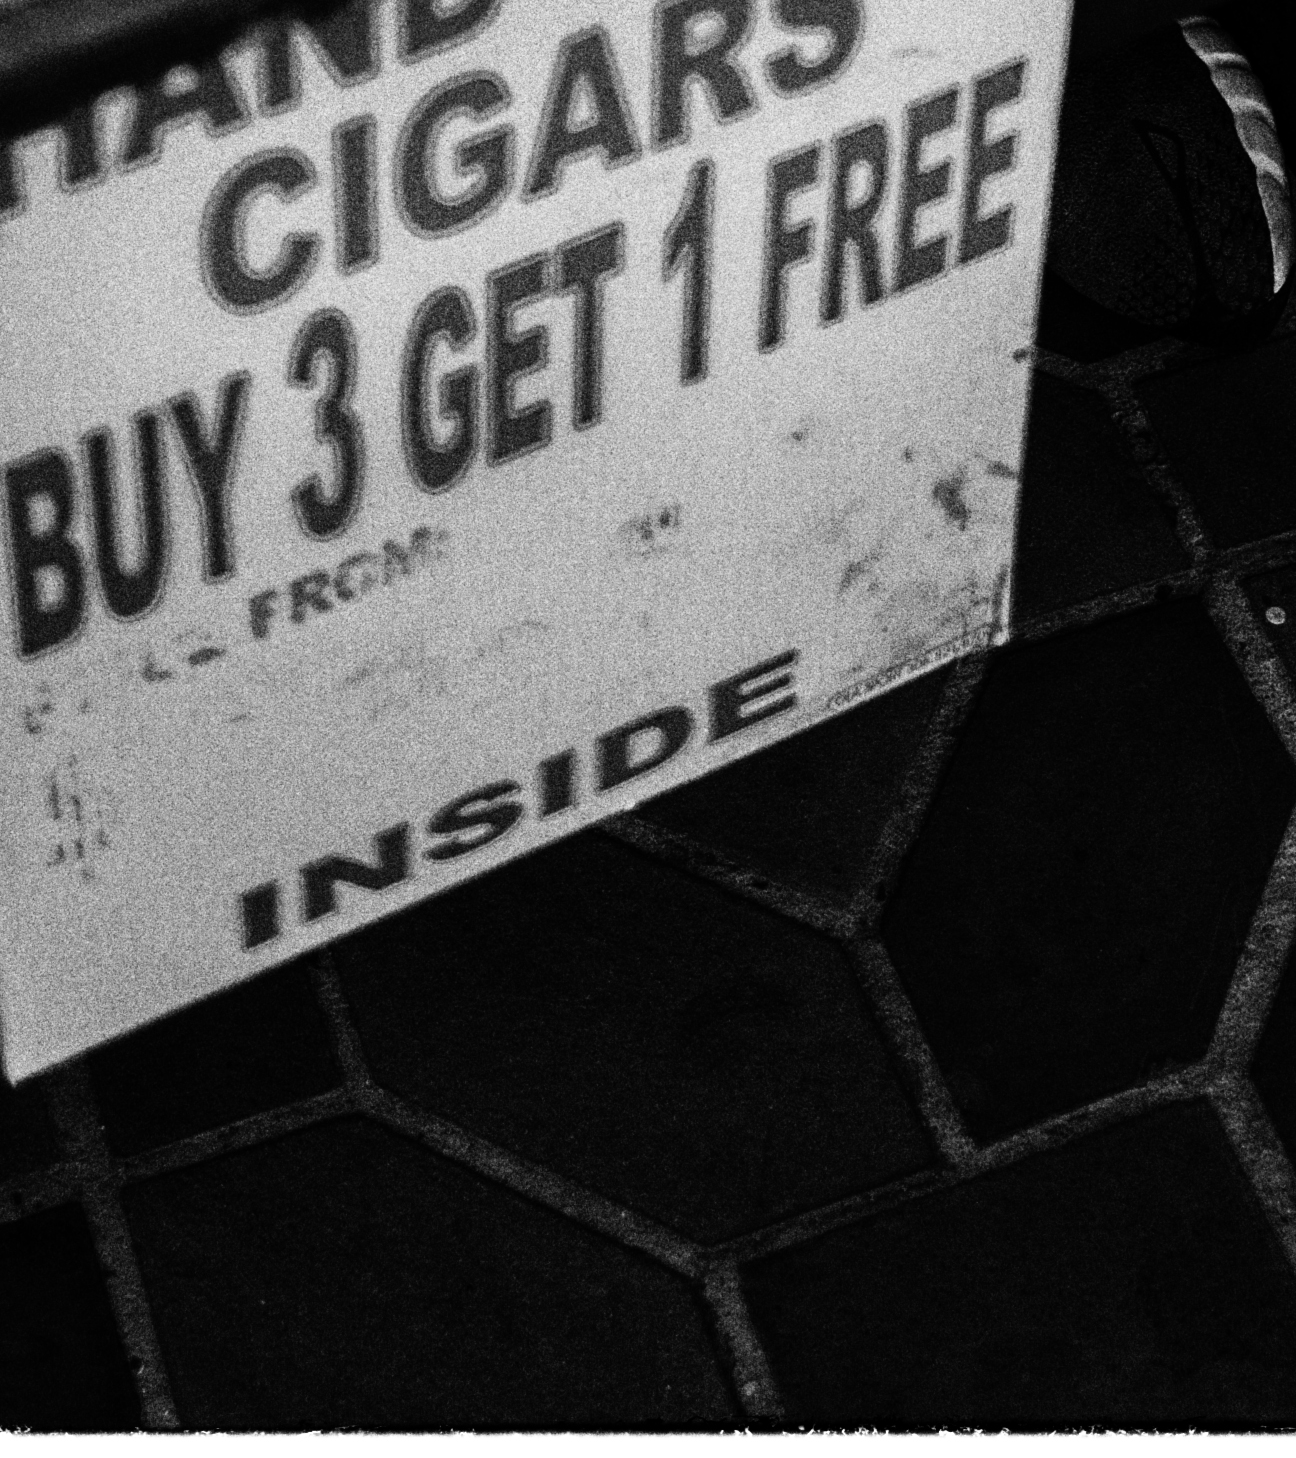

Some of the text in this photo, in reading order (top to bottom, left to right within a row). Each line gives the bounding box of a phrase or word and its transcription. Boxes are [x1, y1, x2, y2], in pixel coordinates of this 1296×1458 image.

[2, 58, 1027, 660] BUY 3 GET 1 FREE
[239, 648, 800, 951] INSIDE
